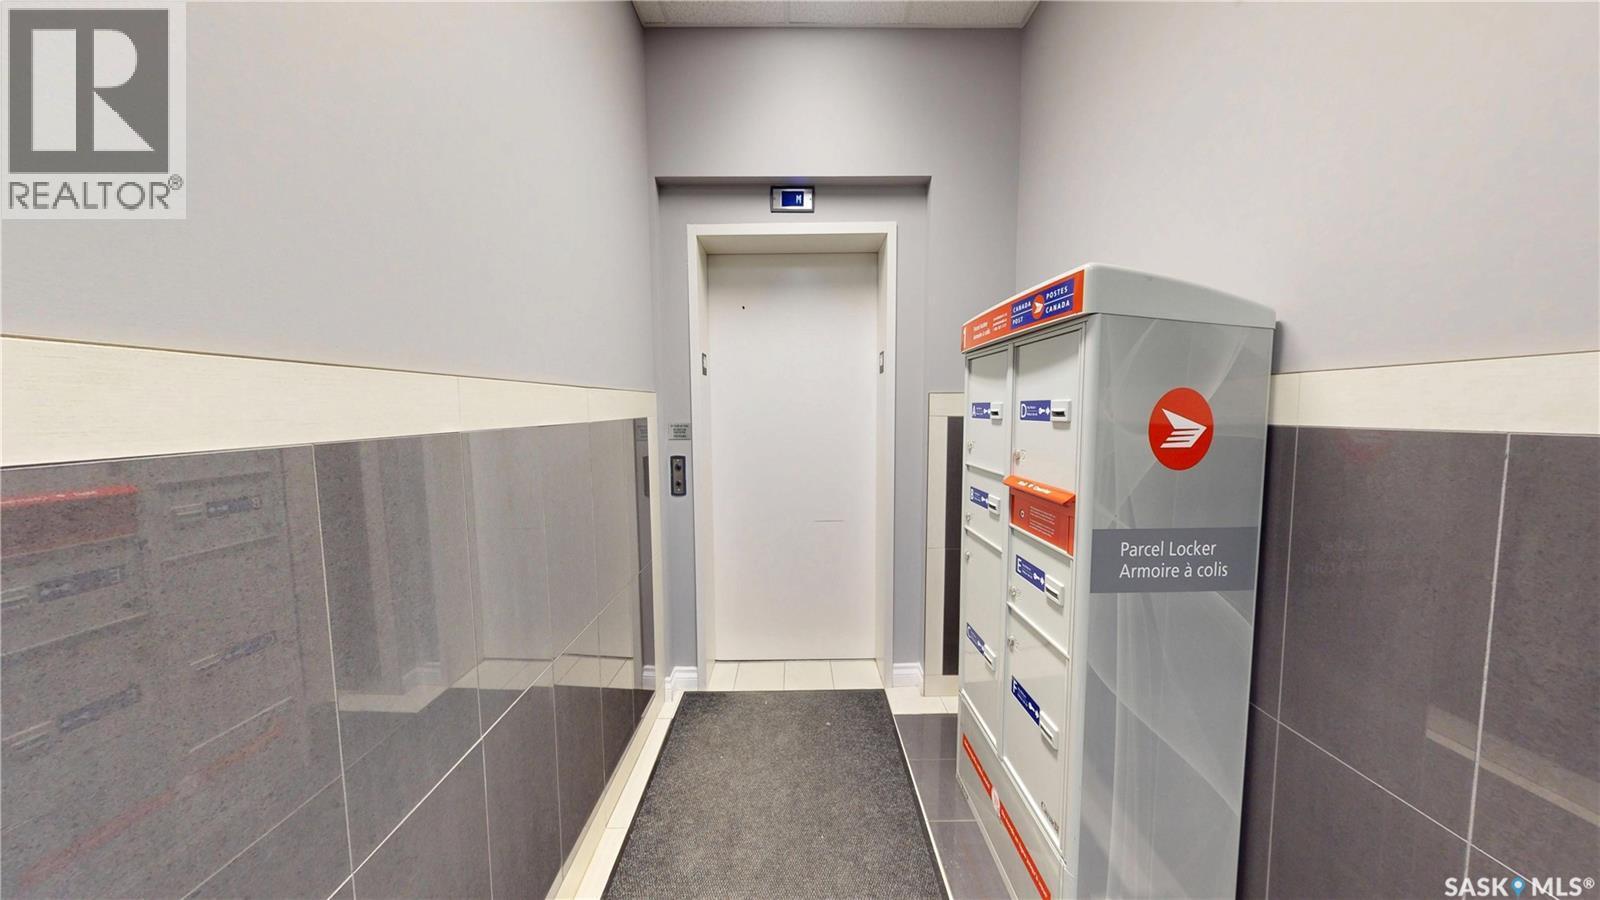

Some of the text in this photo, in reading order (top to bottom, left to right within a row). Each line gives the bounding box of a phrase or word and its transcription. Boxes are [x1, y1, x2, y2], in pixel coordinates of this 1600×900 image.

[795, 194, 802, 204] M
[1045, 285, 1068, 301] POSTES
[1012, 301, 1031, 313] CANADA
[1045, 299, 1070, 314] CANADA
[1012, 316, 1024, 326] POST
[1020, 403, 1028, 418] D
[1120, 540, 1216, 557] Parcel Locker
[1017, 558, 1022, 574] E
[1119, 561, 1228, 579] Armoire à colis
[1012, 680, 1017, 694] F
